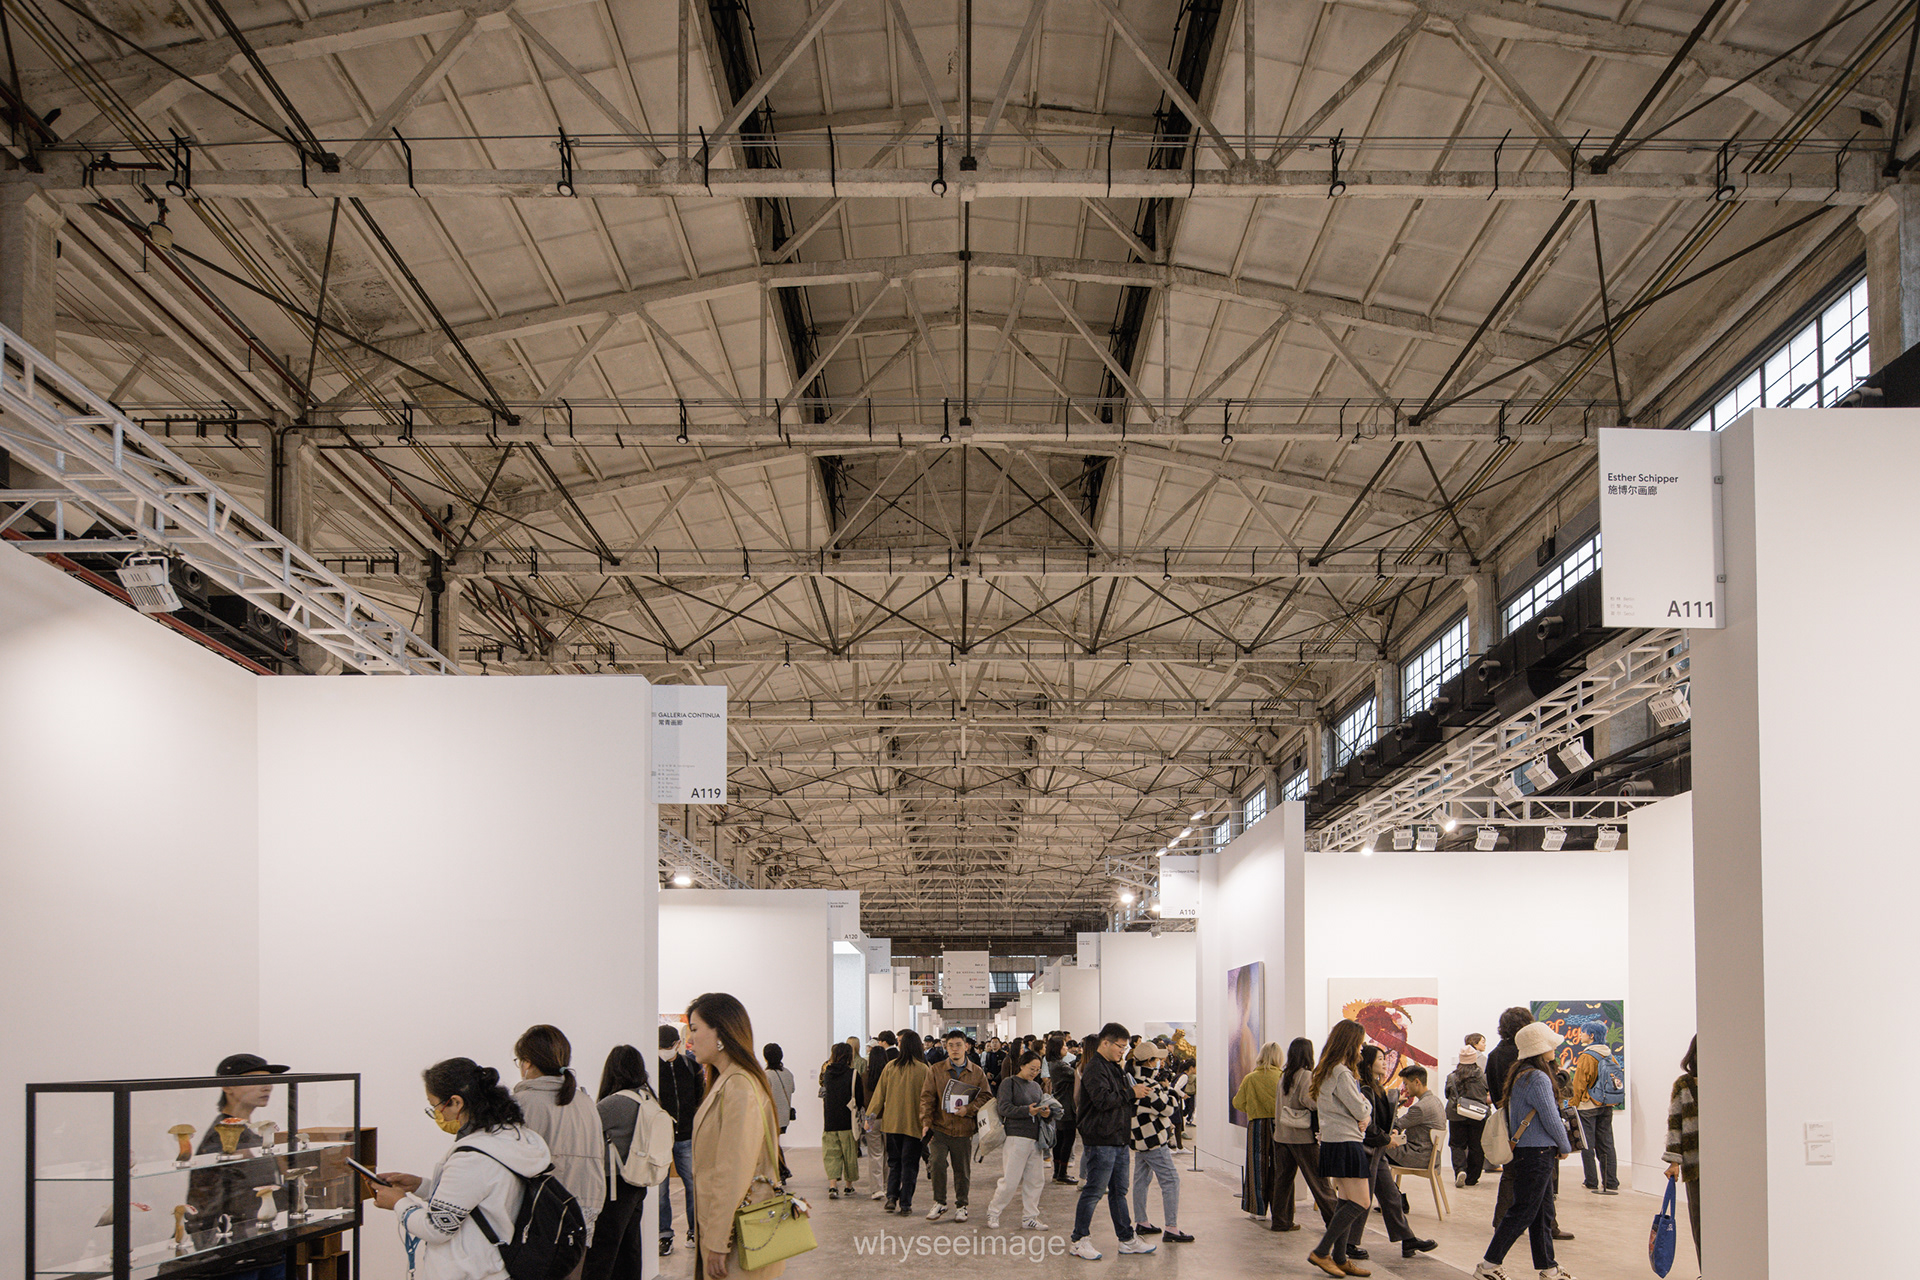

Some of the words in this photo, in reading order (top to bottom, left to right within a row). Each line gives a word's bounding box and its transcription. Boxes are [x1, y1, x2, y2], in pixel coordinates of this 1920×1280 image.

[1608, 473, 1637, 482] Esther
[1638, 473, 1679, 484] Schipper
[1608, 485, 1658, 496] 施博尔画廊
[1667, 600, 1714, 618] A111
[690, 788, 721, 798] A119
